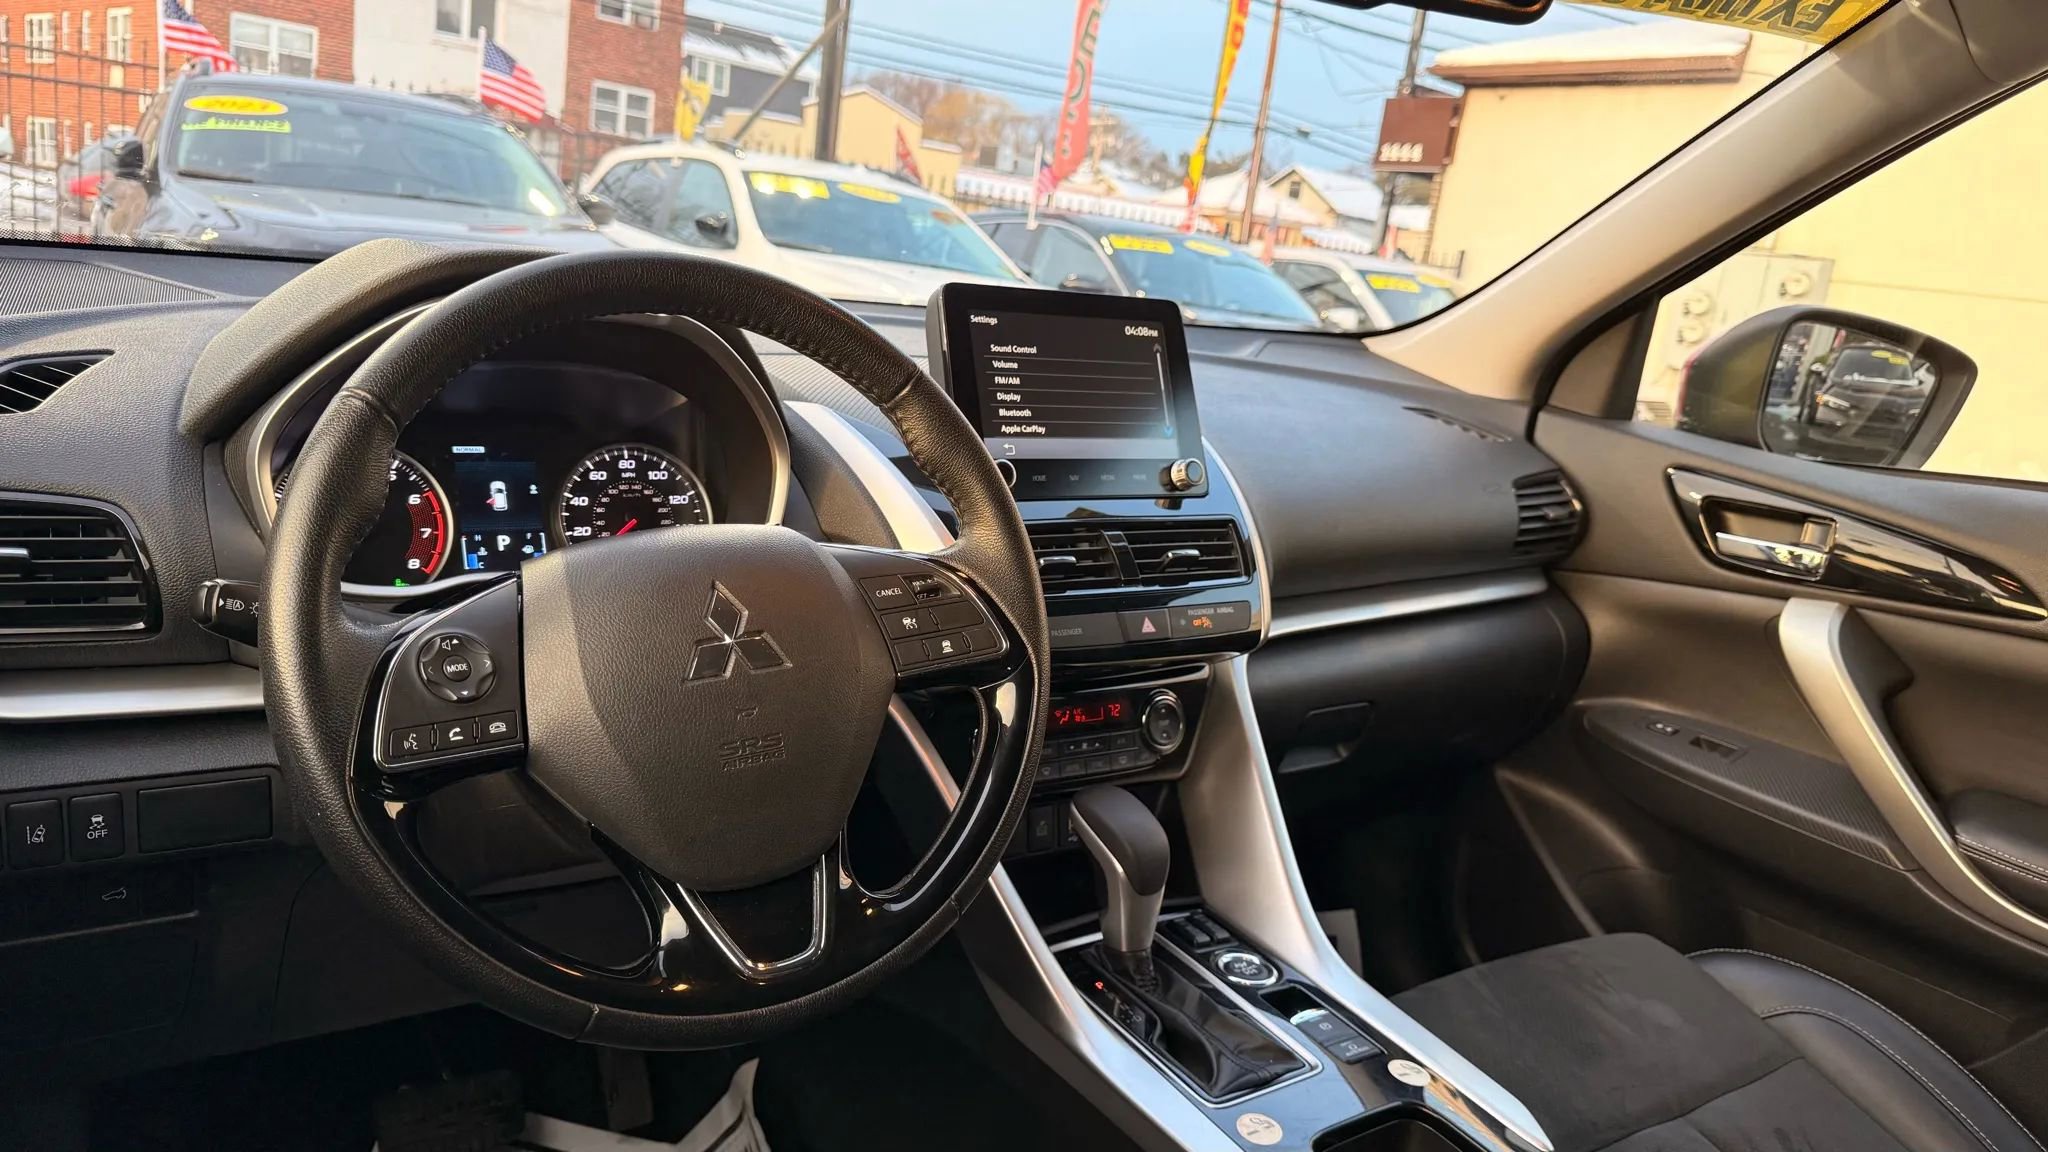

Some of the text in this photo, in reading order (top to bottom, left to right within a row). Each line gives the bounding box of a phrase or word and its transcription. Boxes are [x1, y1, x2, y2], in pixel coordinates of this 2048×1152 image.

[970, 314, 998, 326] Settings
[990, 343, 1037, 354] Sound Control
[992, 360, 1018, 369] Volume
[994, 376, 1021, 385] FM/AM
[996, 392, 1021, 402] Display
[998, 408, 1032, 417] Bluetooth
[1001, 424, 1046, 435] Apple CarPlay
[618, 460, 635, 468] 80
[589, 471, 607, 480] 60
[648, 471, 668, 479] 100
[408, 494, 421, 504] 6
[570, 497, 588, 505] 40
[669, 495, 688, 504] 120
[420, 527, 432, 539] 7
[573, 527, 591, 536] 20
[497, 535, 510, 551] P
[407, 557, 420, 569] 8
[875, 587, 903, 598] CANCEL
[446, 662, 469, 674] MODE
[1108, 703, 1121, 718] 72
[86, 828, 109, 840] OFF
